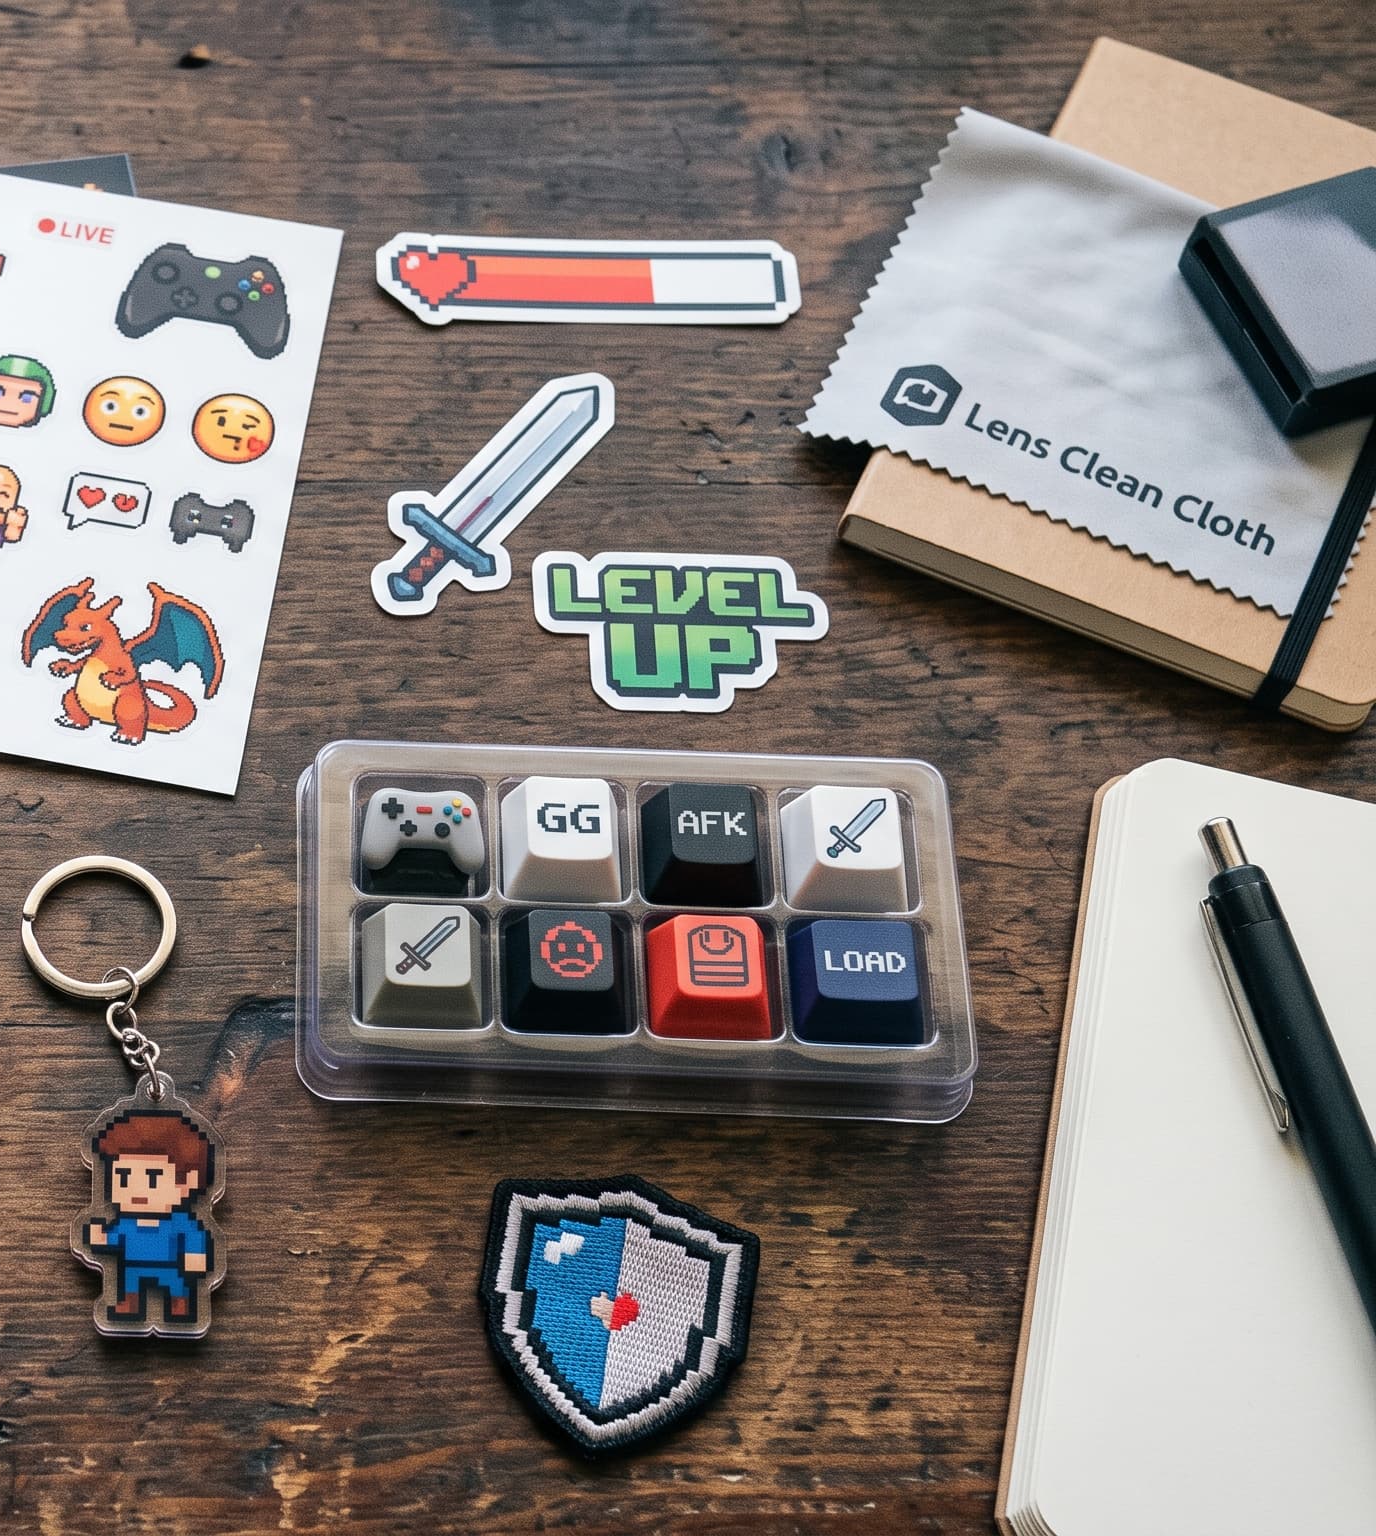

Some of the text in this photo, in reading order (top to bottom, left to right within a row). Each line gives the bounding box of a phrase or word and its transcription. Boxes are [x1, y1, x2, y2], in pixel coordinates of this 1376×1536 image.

[60, 221, 115, 244] LIVE
[964, 404, 1277, 556] Lens Clean Cloth
[551, 564, 814, 624] LEVEL
[607, 622, 760, 695] UP
[536, 802, 602, 834] GG
[677, 809, 748, 837] AFK
[823, 950, 906, 974] LOAD
